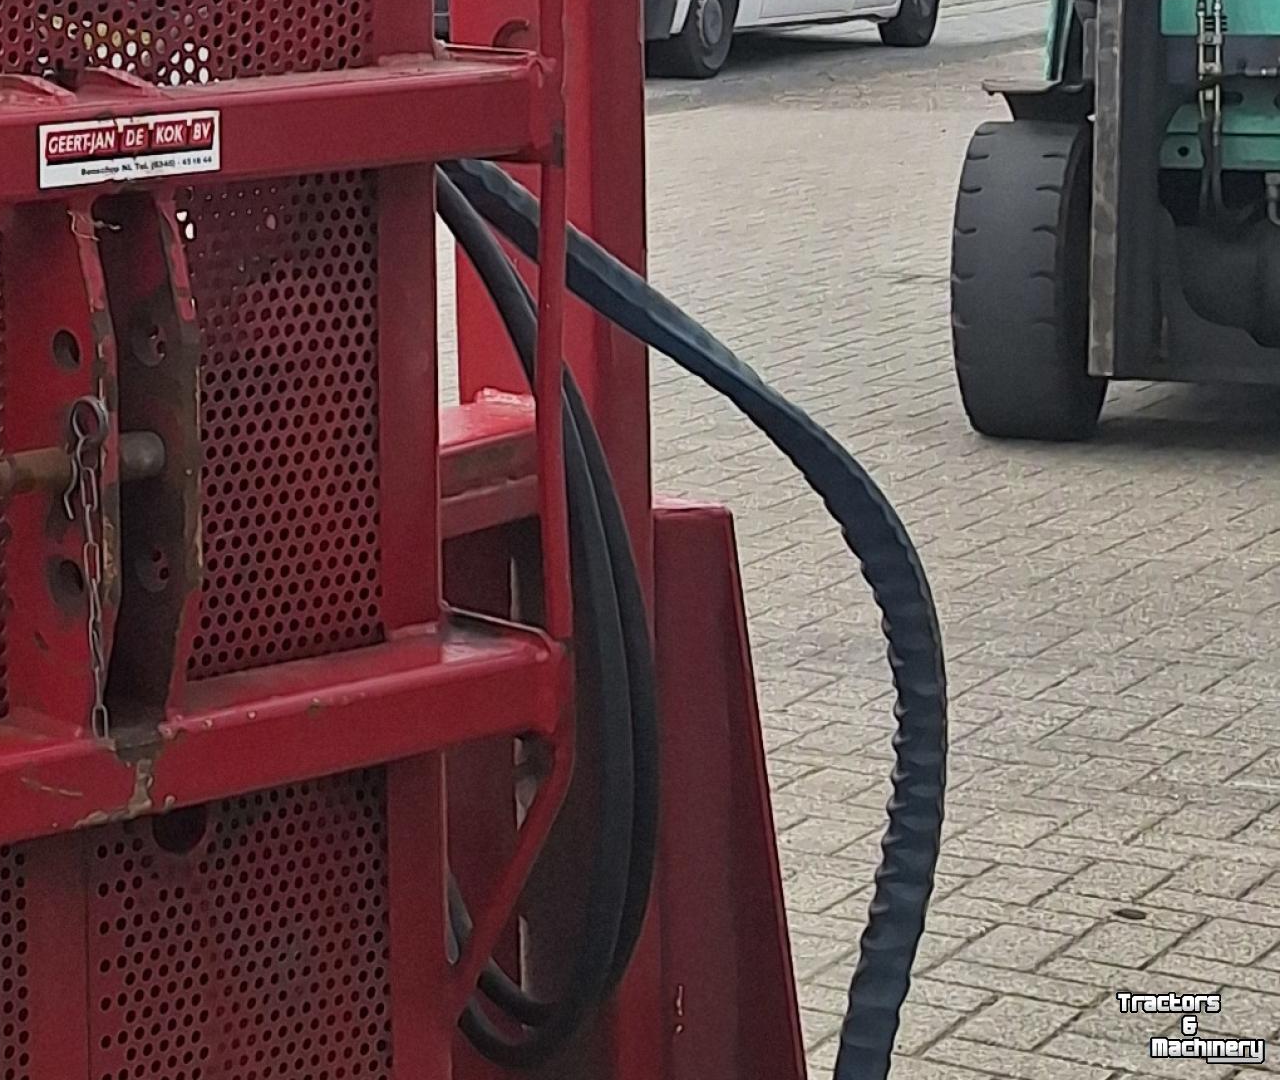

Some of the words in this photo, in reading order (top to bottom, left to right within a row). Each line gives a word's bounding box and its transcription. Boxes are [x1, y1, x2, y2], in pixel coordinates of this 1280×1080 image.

[48, 130, 115, 154] GEERT-JAN
[125, 128, 144, 147] DE
[156, 124, 183, 144] KOK
[192, 122, 212, 141] BV
